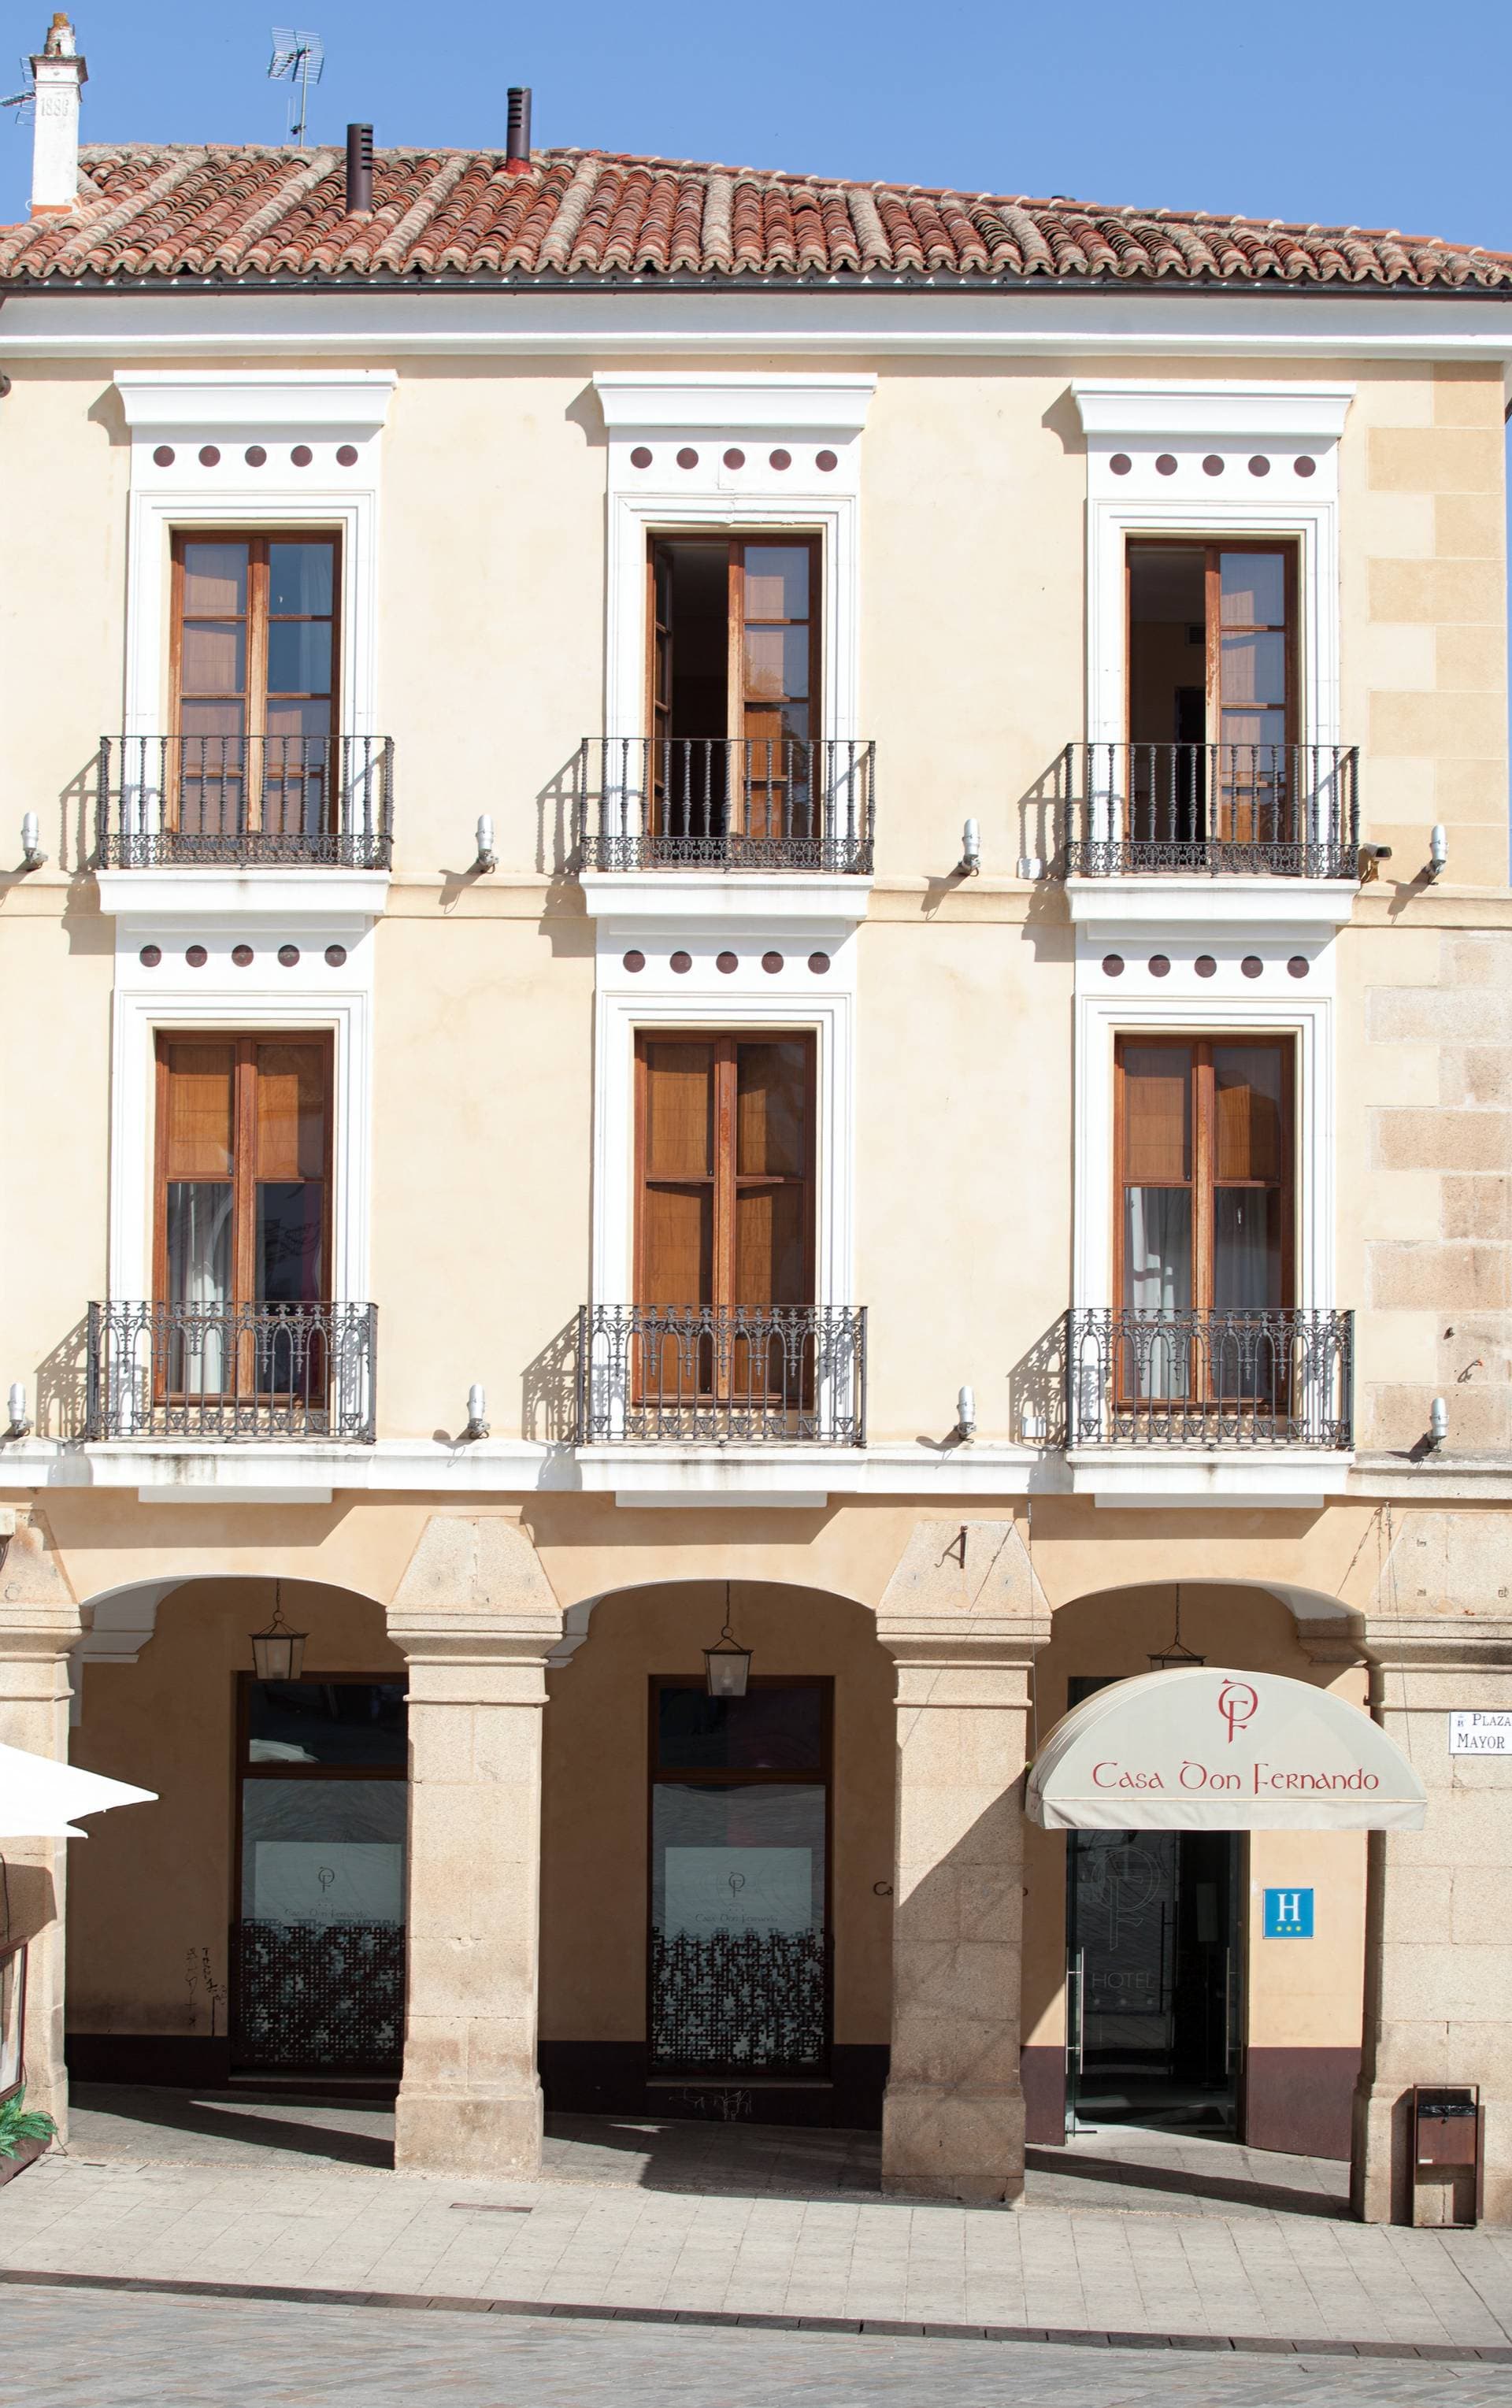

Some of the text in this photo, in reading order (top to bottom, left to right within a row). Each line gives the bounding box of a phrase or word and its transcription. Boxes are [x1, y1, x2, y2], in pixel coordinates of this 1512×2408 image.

[1472, 1713, 1511, 1726] PLAZA
[1457, 1732, 1505, 1749] MAYOR
[1092, 1760, 1380, 1795] Casa Don Fernando
[1277, 1893, 1301, 1921] H
[1091, 1972, 1154, 1989] HOTEL
